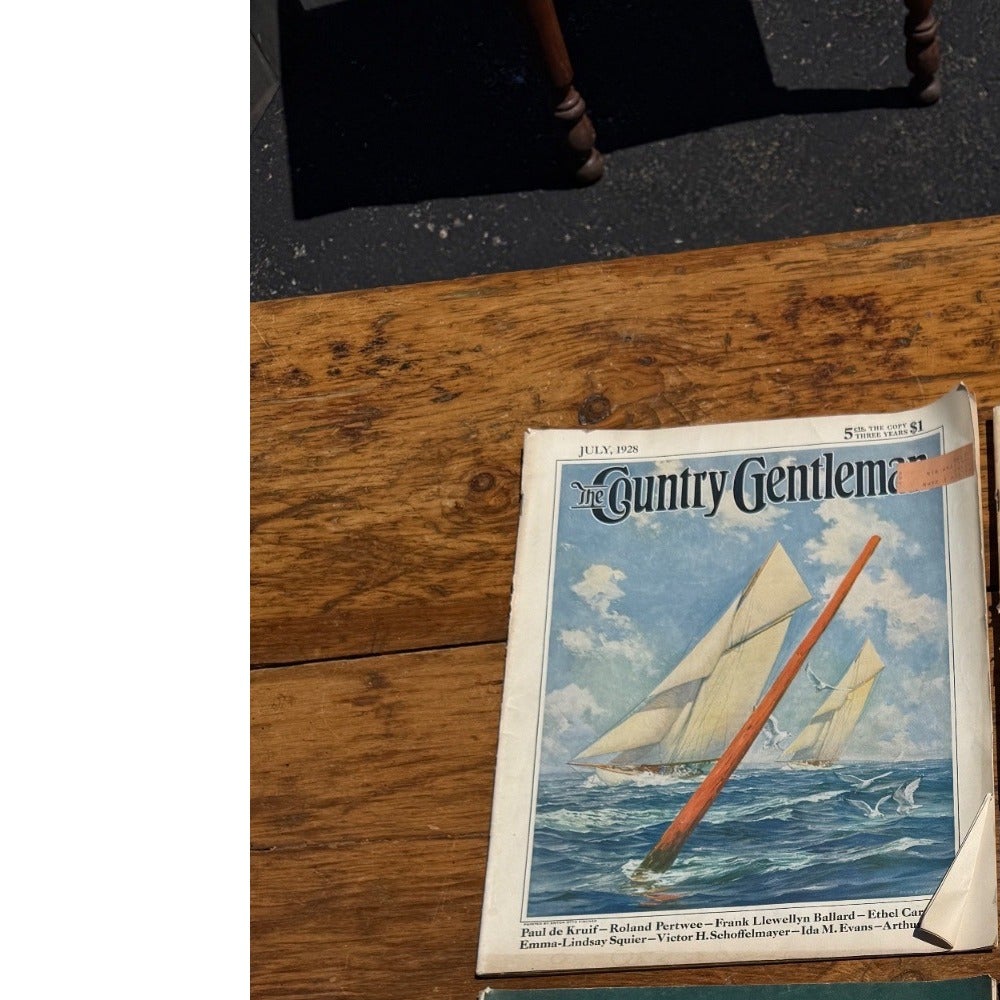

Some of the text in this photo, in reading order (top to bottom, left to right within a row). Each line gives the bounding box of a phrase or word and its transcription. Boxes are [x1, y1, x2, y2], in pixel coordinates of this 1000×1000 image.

[844, 428, 854, 440] 5
[868, 424, 885, 432] THE
[887, 423, 907, 431] COPY
[855, 431, 884, 439] THREE
[910, 420, 924, 434] $1
[579, 445, 639, 458] JULY, 1928
[570, 482, 605, 508] The
[592, 466, 729, 524] Country
[733, 452, 928, 514] Gentlem
[519, 936, 606, 950] Emma-Lindsay
[822, 923, 837, 934] M.
[882, 919, 919, 931] Arthu
[520, 926, 546, 938] Paul
[549, 925, 563, 936] de
[753, 913, 810, 926] Llewellyn
